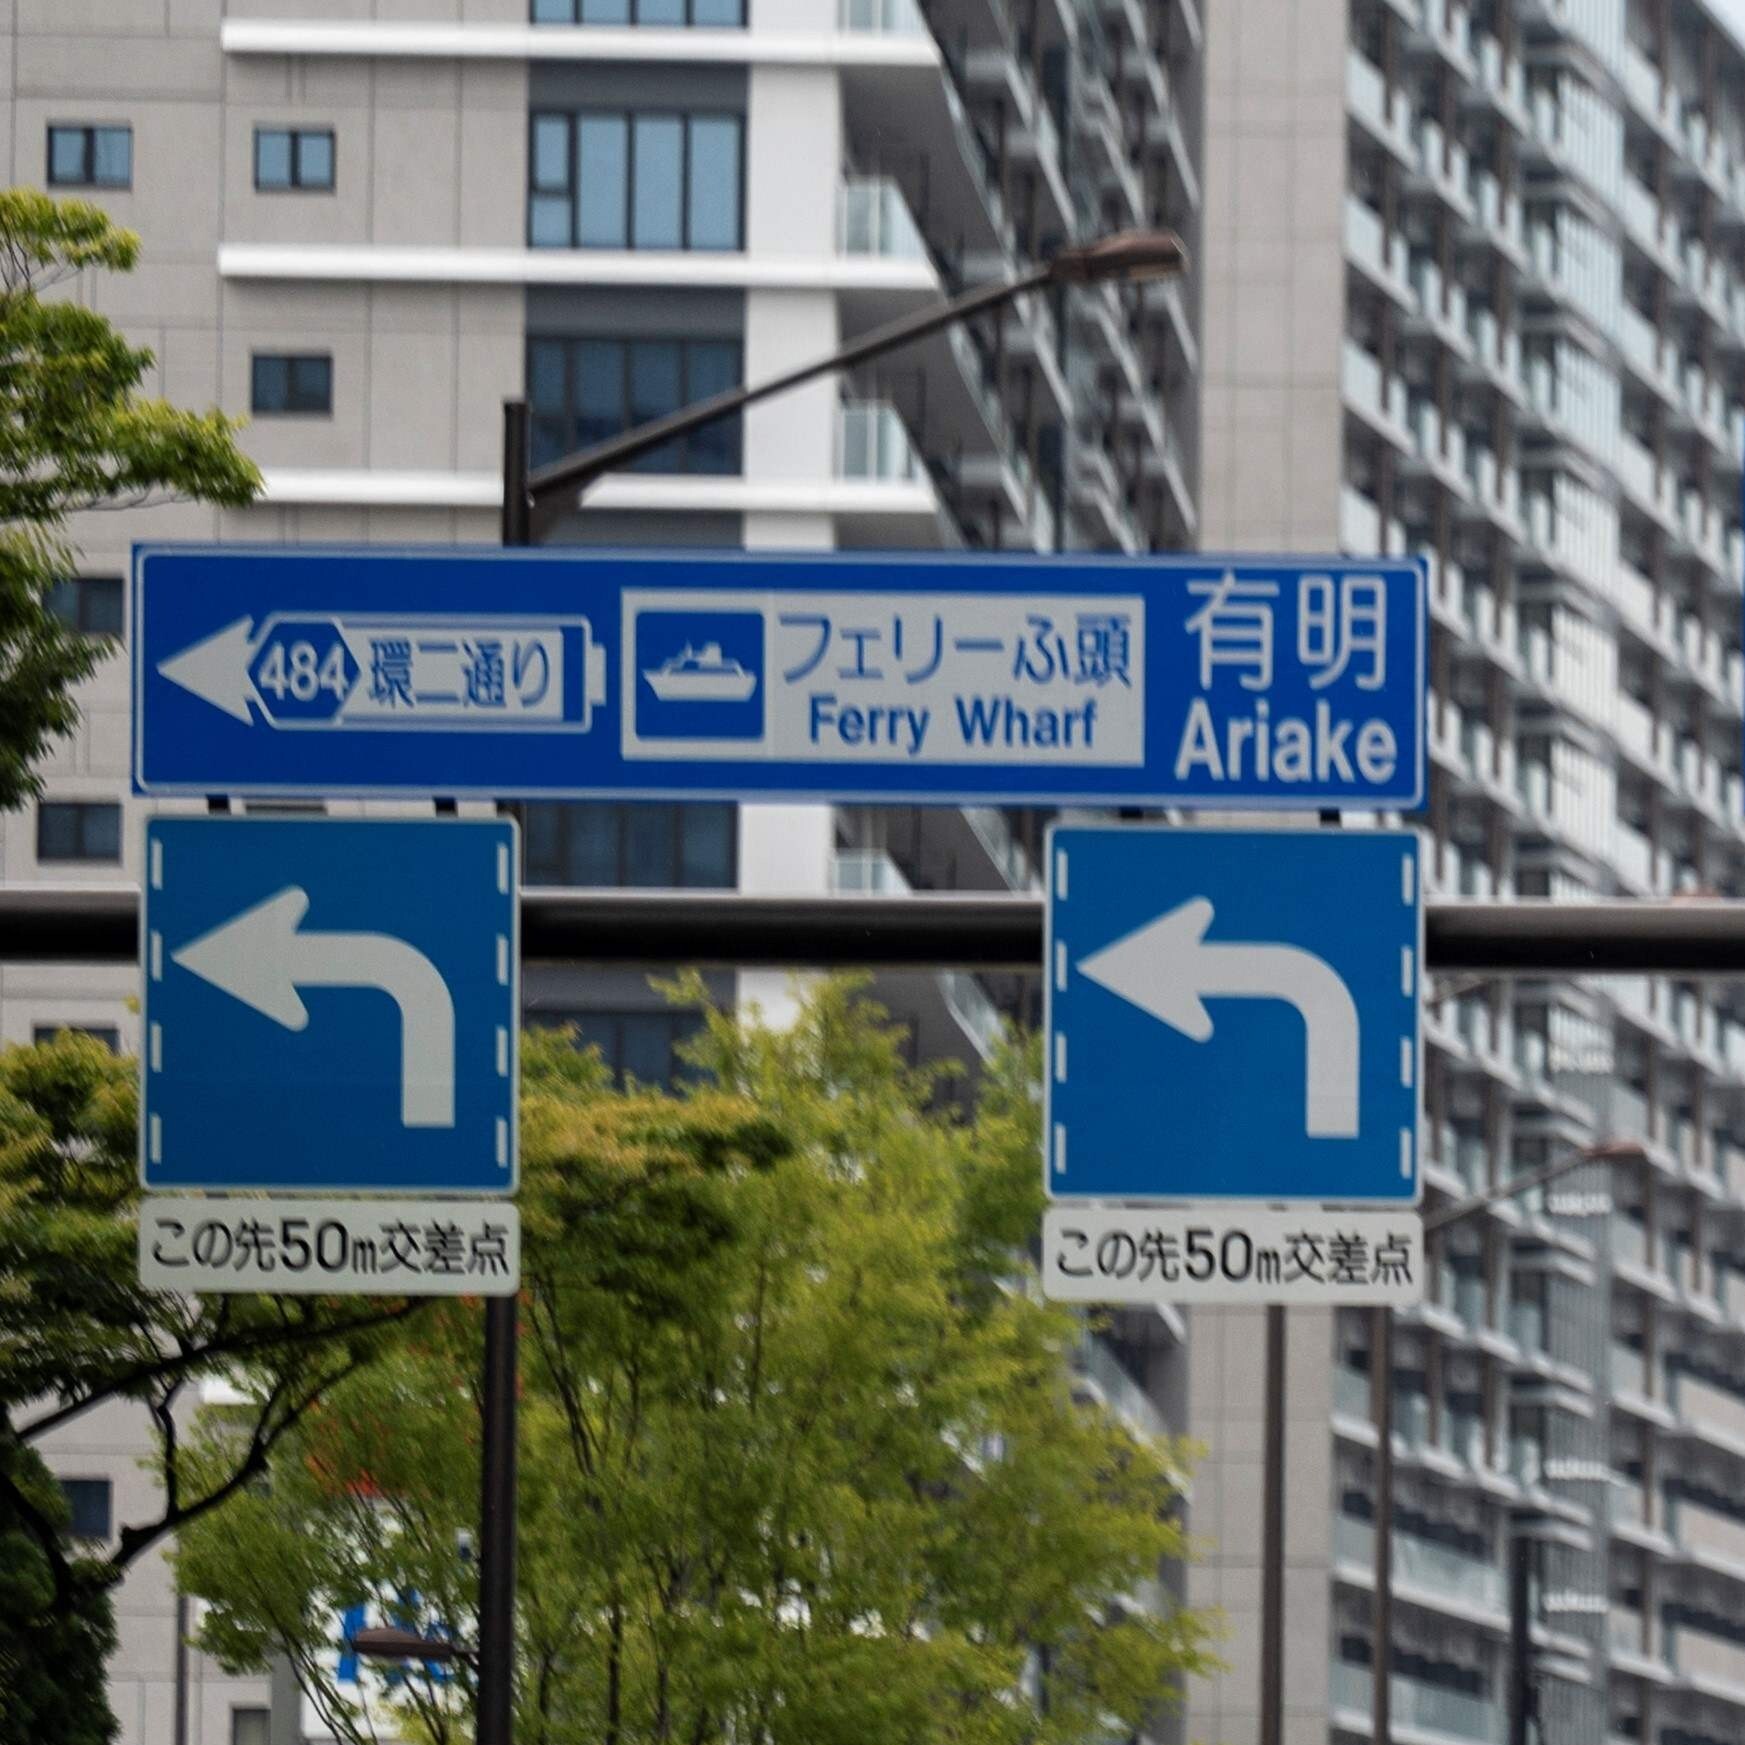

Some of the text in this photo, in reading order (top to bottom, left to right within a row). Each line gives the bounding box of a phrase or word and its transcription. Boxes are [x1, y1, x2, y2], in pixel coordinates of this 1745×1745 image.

[256, 628, 556, 708] 484 環二通り
[778, 612, 1134, 690] フェリーふ頭
[1182, 571, 1389, 695] 有明
[808, 696, 1099, 756] Ferry Wharf
[1172, 700, 1397, 783] Ariake
[151, 1217, 510, 1278] この先50m交差点
[1055, 1224, 1414, 1286] この先50m交差点
